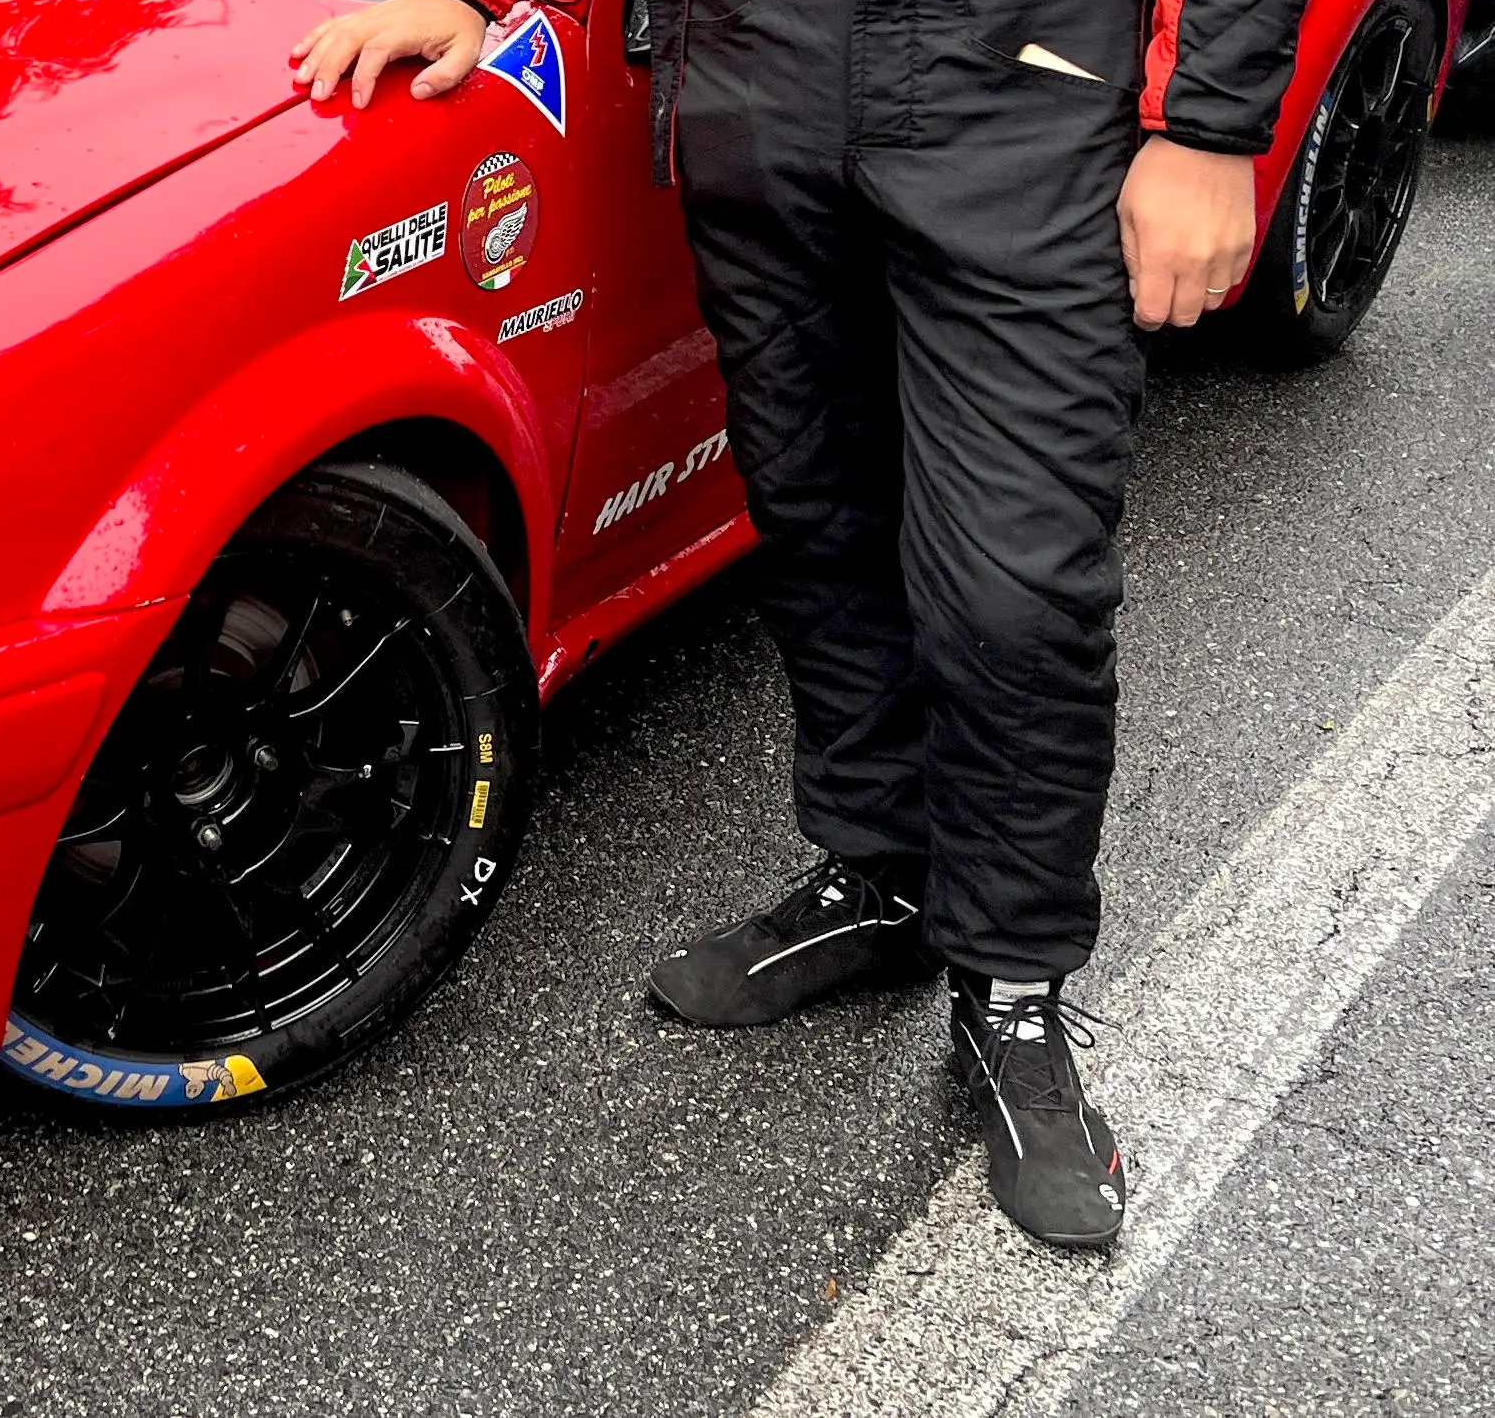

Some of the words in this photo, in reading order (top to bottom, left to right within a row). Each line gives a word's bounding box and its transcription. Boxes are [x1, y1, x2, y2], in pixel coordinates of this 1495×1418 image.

[1295, 104, 1329, 264] MICHELIN
[362, 222, 406, 261] QUELLI
[409, 204, 447, 236] DELLE
[373, 223, 446, 277] SALITE
[498, 290, 583, 342] MAURIELLO
[592, 462, 674, 535] HAIR
